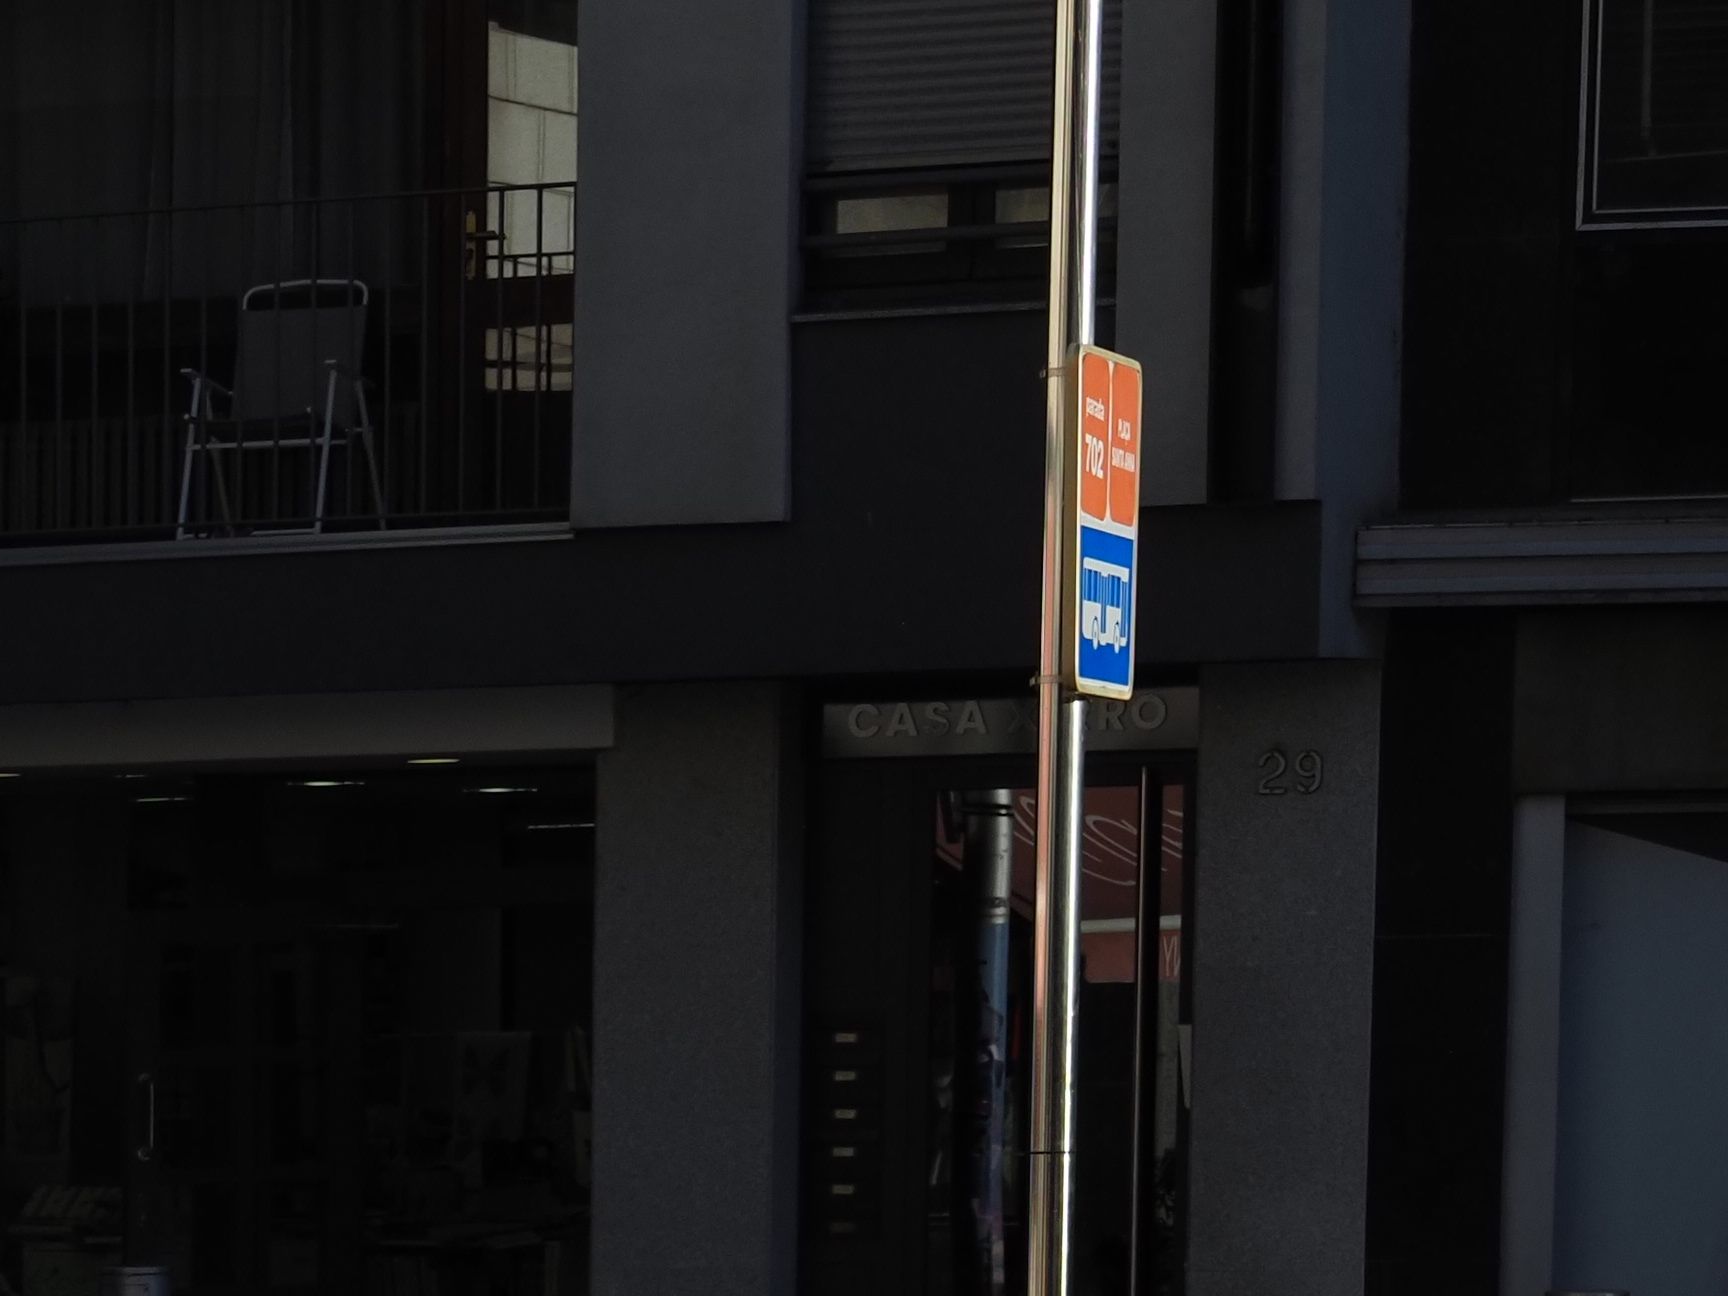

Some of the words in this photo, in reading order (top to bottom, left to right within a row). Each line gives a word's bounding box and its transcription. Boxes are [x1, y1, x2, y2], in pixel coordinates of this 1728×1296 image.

[1085, 432, 1104, 480] 702
[847, 700, 988, 738] CASA
[1258, 748, 1323, 796] 29
